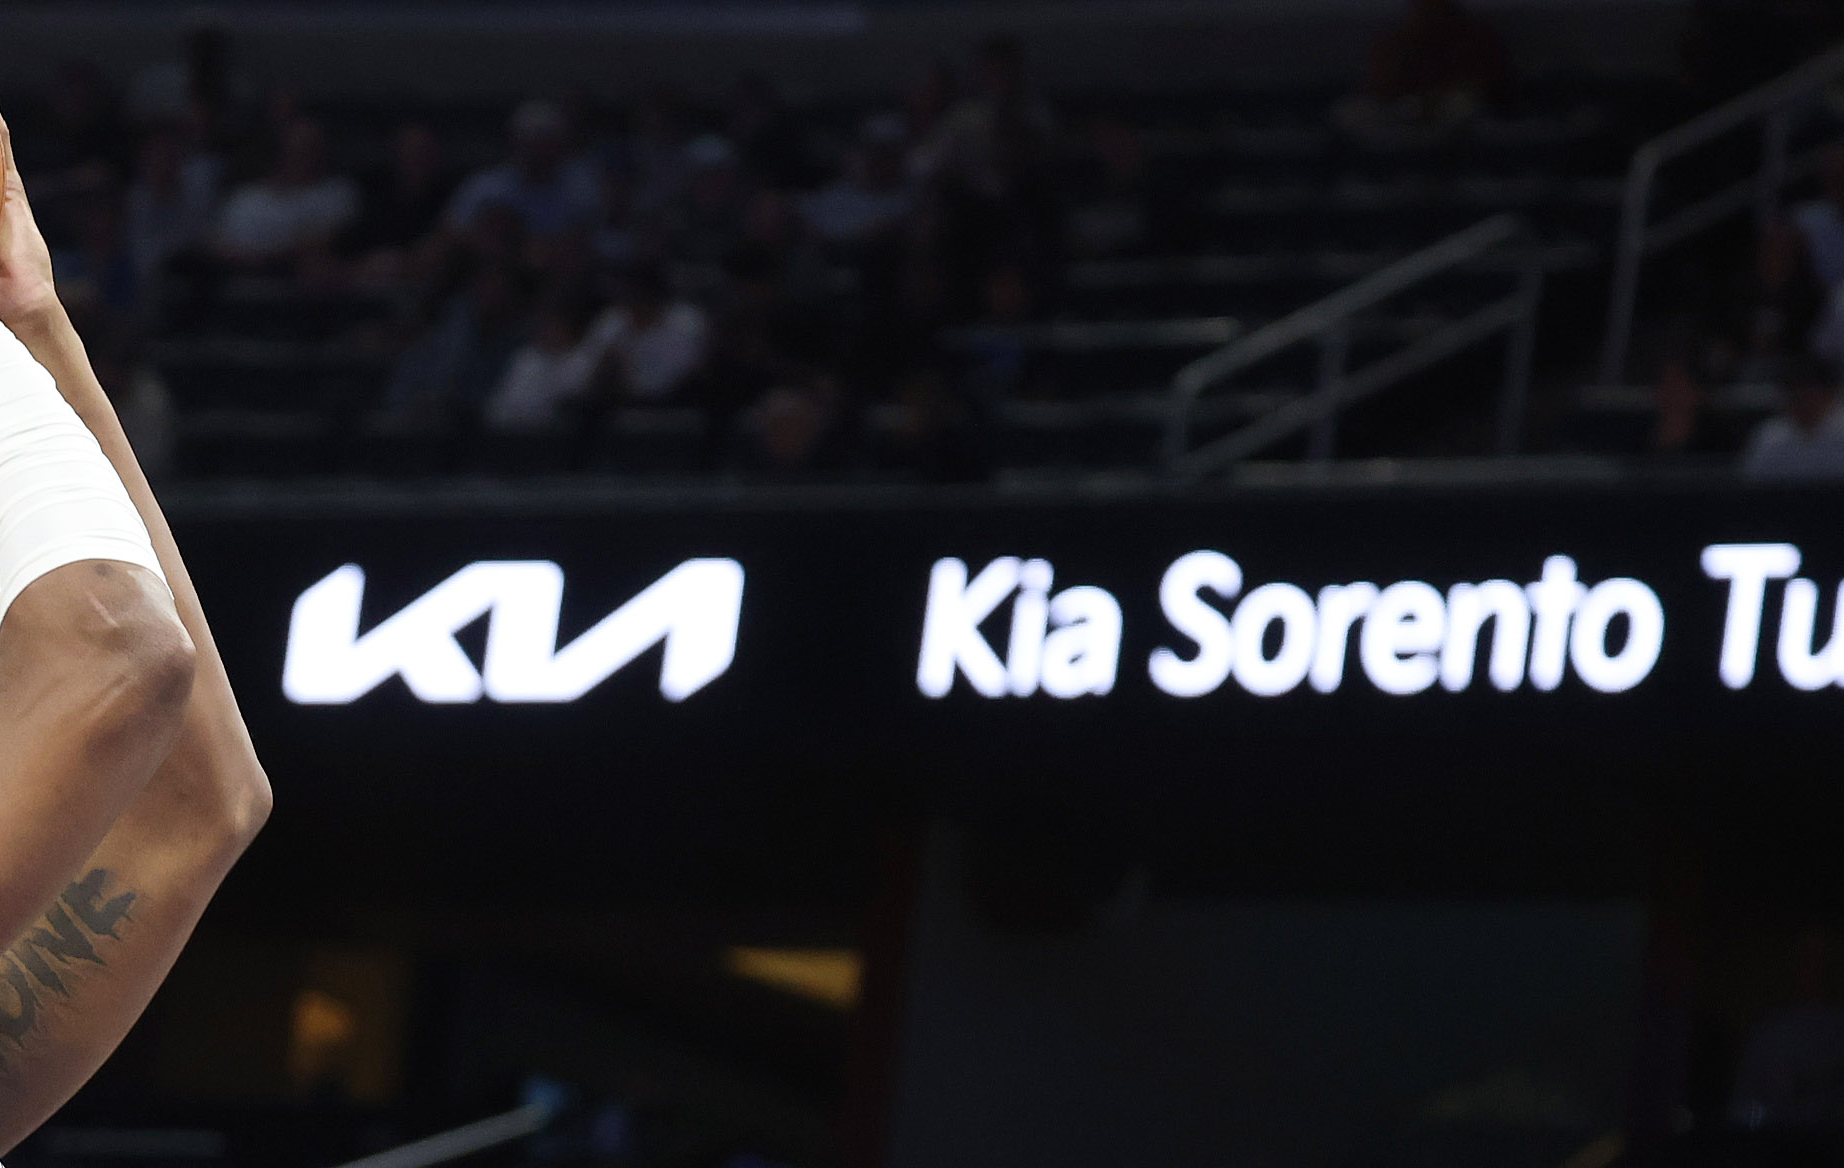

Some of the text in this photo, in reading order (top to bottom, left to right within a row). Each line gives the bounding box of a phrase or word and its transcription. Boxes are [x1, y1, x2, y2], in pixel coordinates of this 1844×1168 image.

[281, 556, 746, 706] KIA
[916, 556, 1123, 699] Kia
[1148, 550, 1665, 697] Sorento
